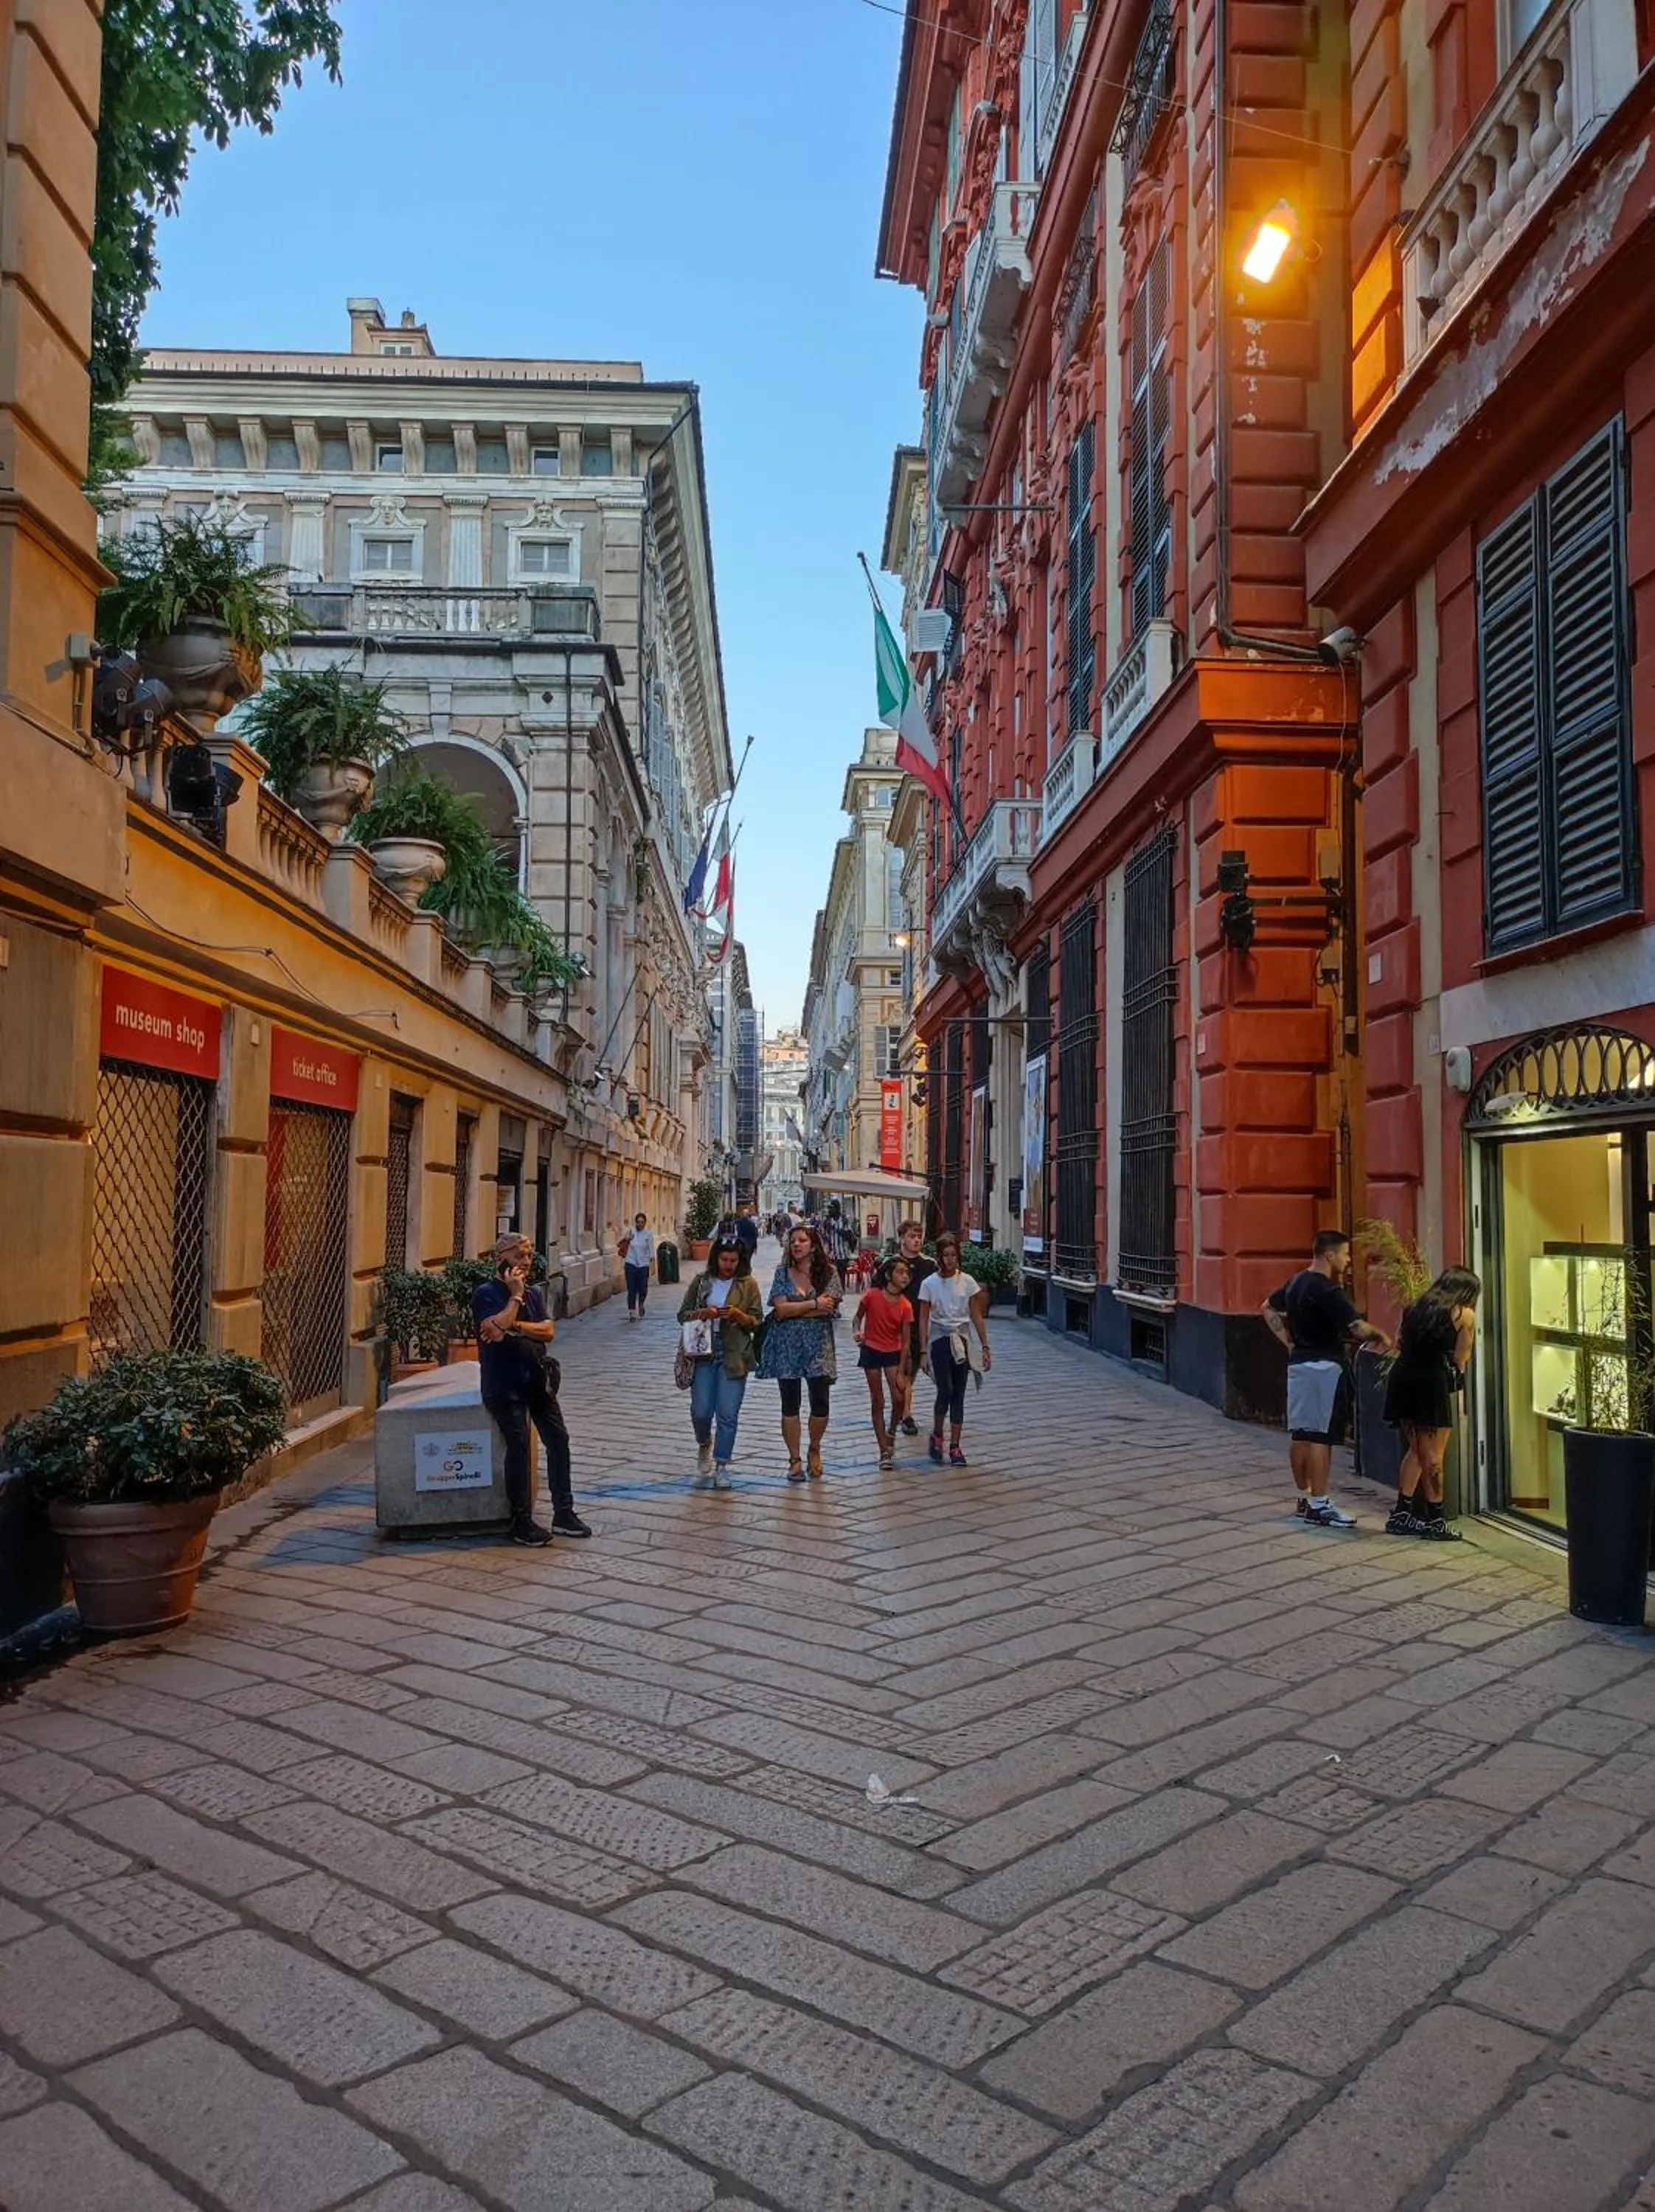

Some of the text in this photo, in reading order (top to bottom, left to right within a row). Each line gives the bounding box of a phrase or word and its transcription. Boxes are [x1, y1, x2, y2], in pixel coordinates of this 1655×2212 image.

[115, 1004, 205, 1054] museum shop
[293, 1057, 337, 1086] ticket office
